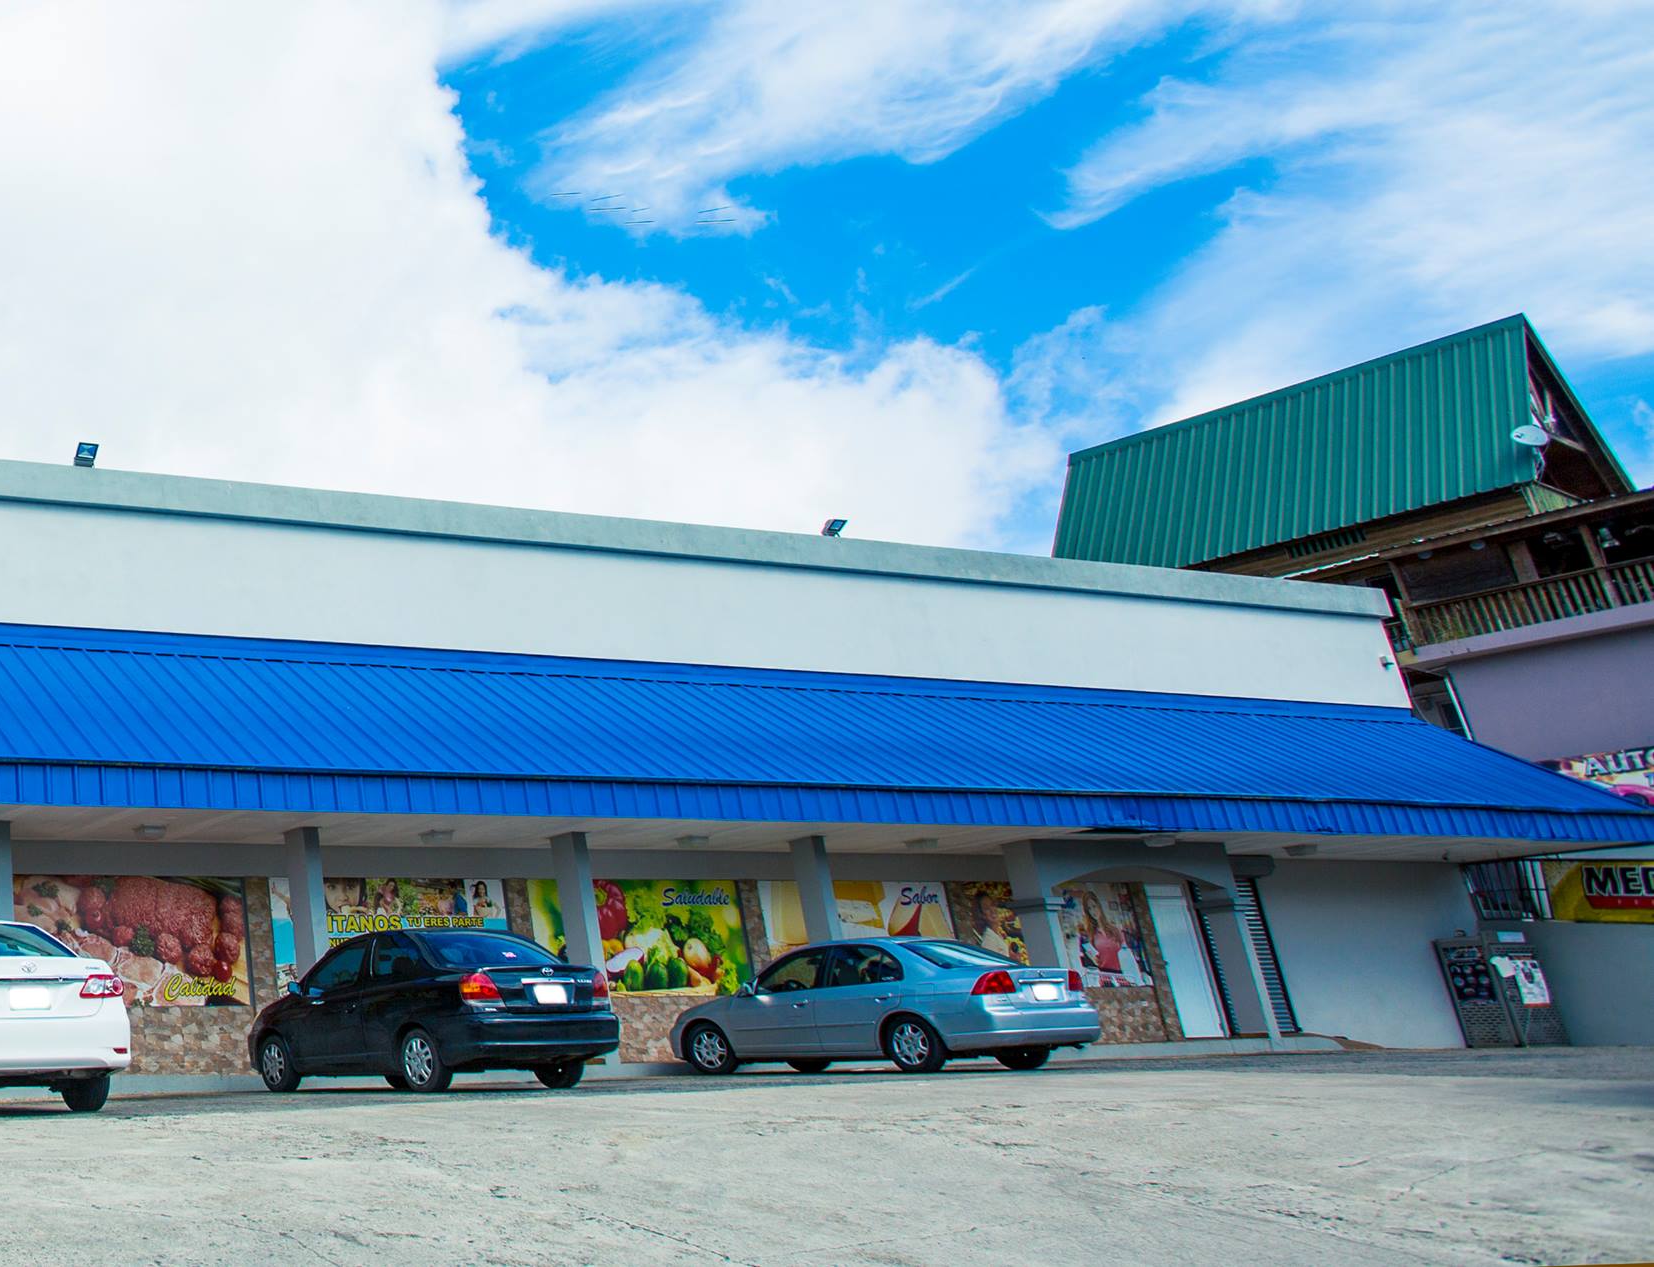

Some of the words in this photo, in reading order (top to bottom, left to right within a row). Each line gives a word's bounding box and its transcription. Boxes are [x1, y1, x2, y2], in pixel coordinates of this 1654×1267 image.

[661, 887, 730, 906] Saludable
[900, 886, 938, 905] Sabor
[327, 911, 402, 933] ÍTANOS
[407, 916, 422, 928] TU
[424, 916, 450, 928] ERES
[452, 916, 484, 928] PARTE
[164, 973, 237, 1001] Calidad
